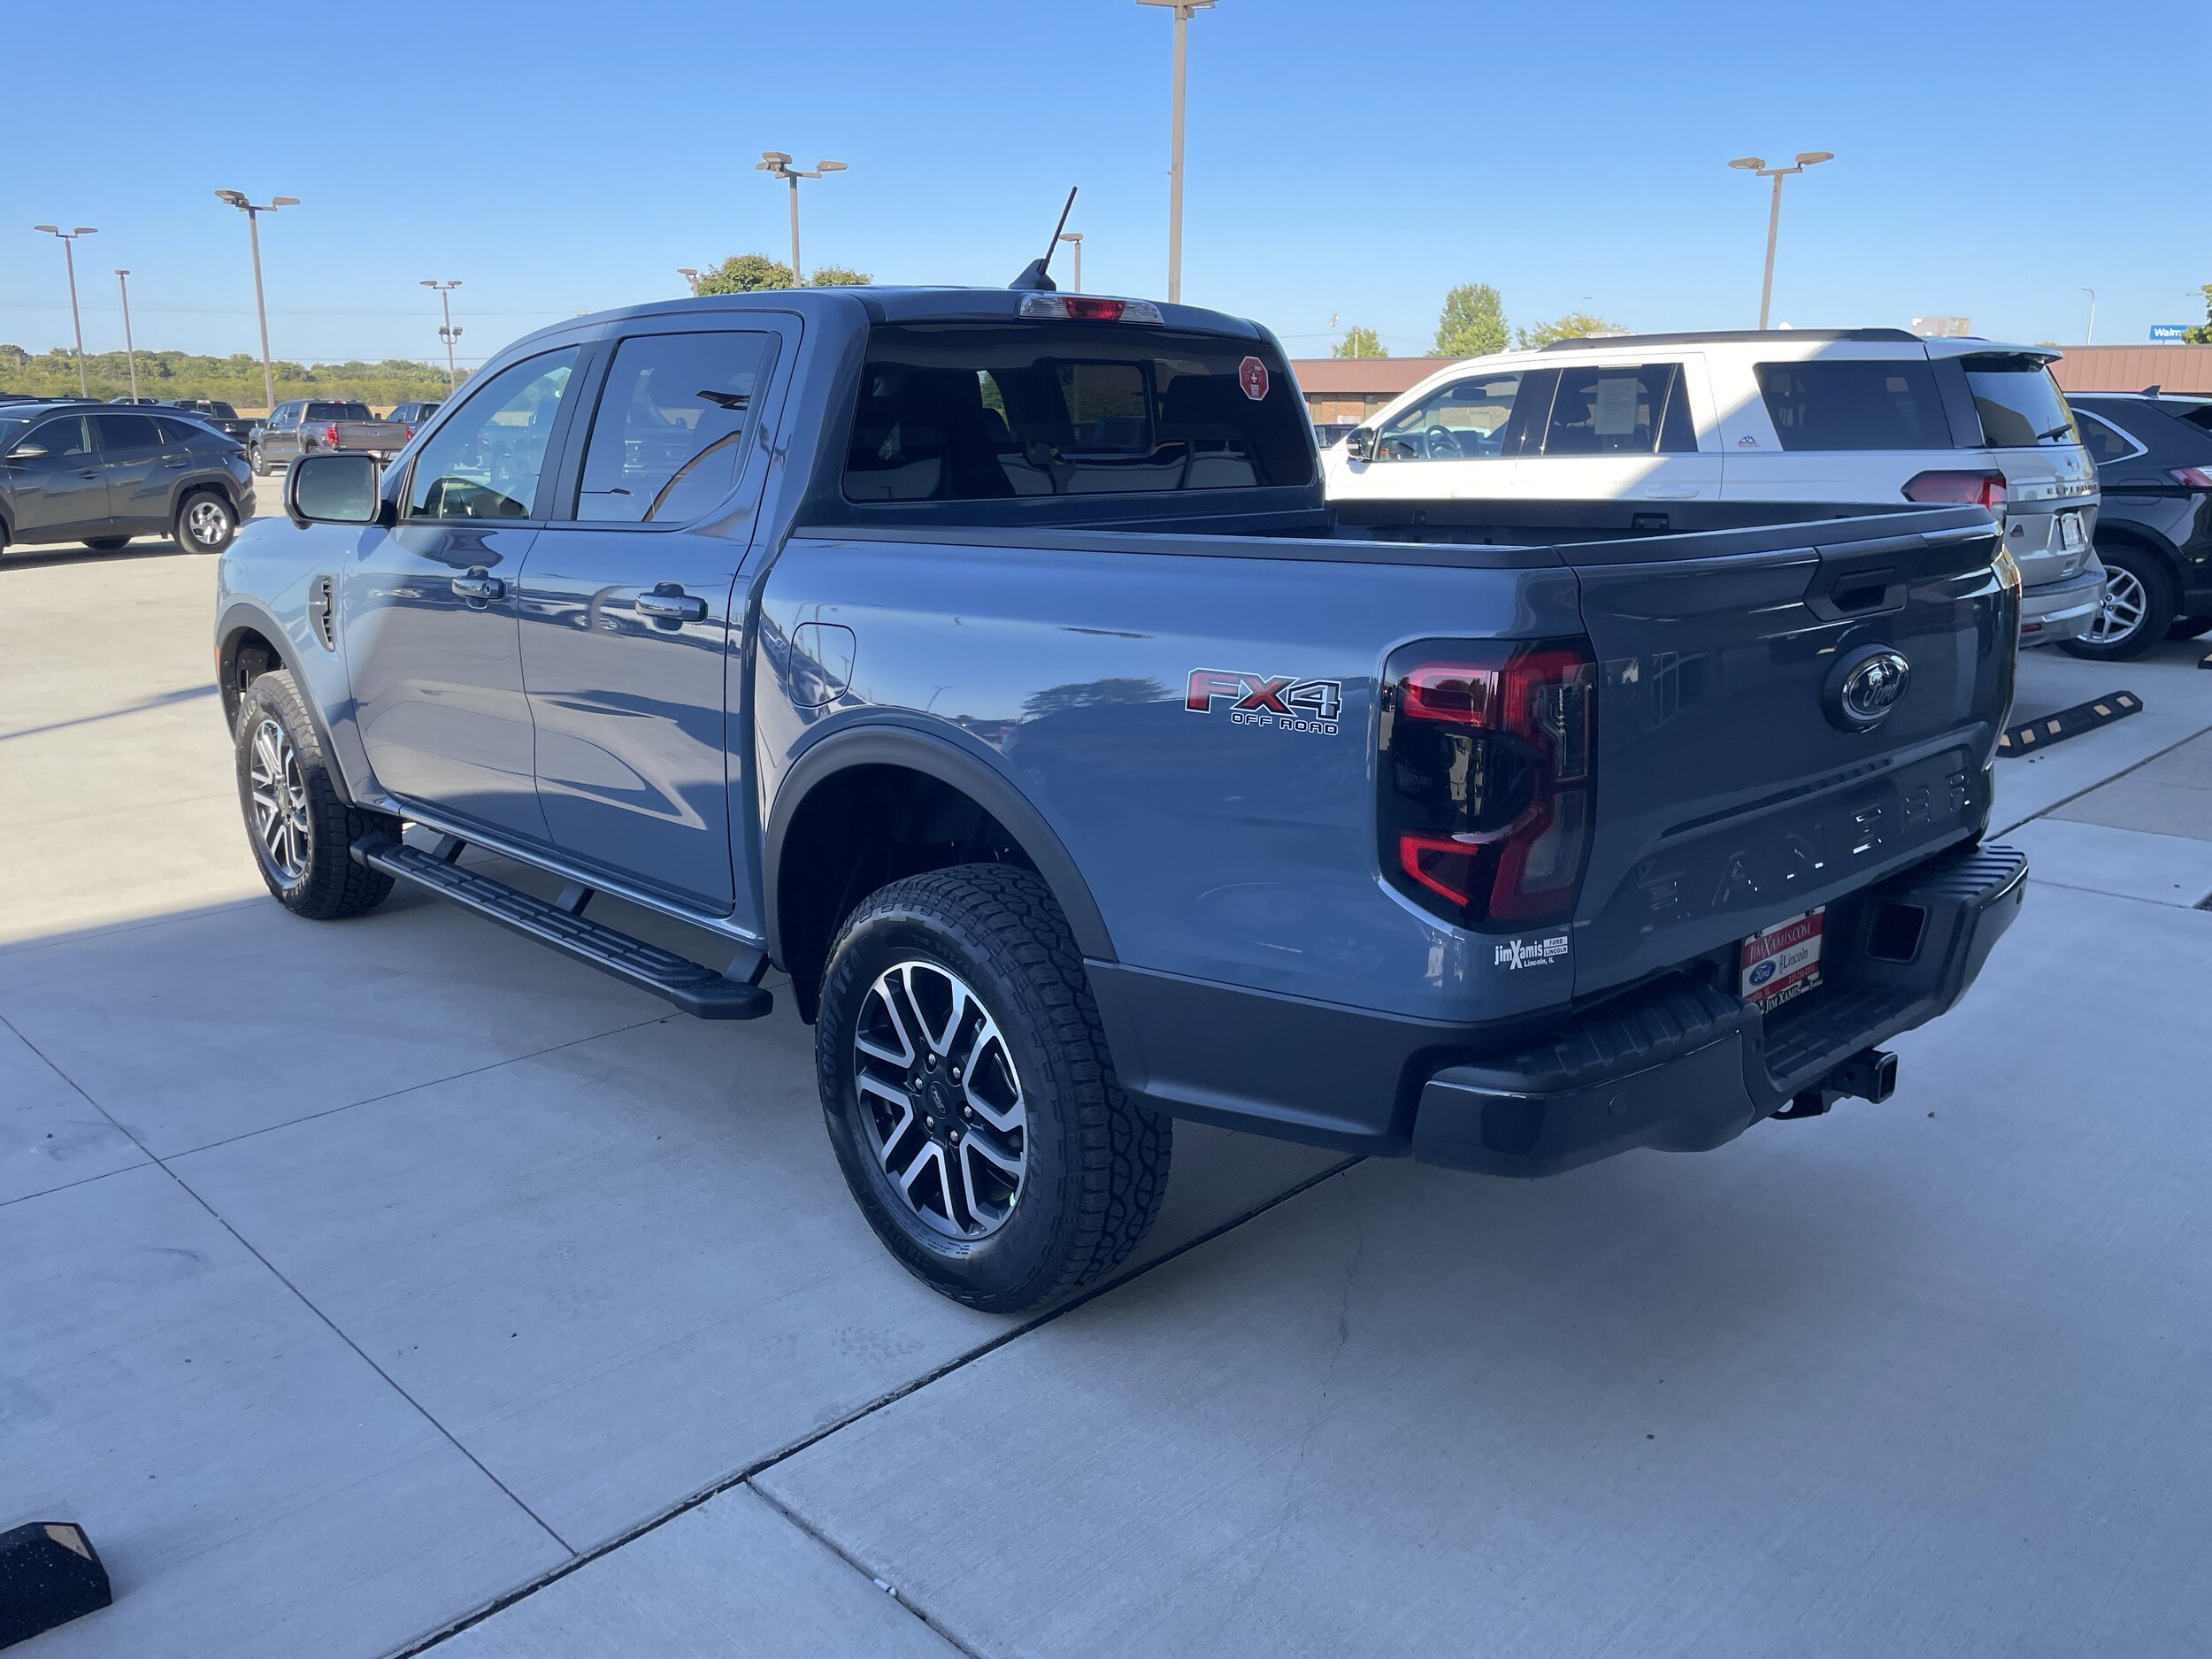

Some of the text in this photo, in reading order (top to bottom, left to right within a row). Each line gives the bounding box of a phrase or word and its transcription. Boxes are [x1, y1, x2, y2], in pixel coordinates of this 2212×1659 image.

[2154, 327, 2182, 337] Walm
[1185, 667, 1342, 722] FX4
[1863, 665, 1901, 707] Ford
[1231, 711, 1339, 736] OFF ROAD
[1494, 939, 1543, 971] jimXamis
[1524, 957, 1548, 968] Lincoln,
[1545, 946, 1567, 956] LINCOLN
[1783, 947, 1809, 969] Lincoln
[1754, 964, 1771, 982] Ford
[1765, 996, 1778, 1014] JIM
[1778, 987, 1801, 1005] XAMIS
[821, 936, 871, 1099] GOODYEA
